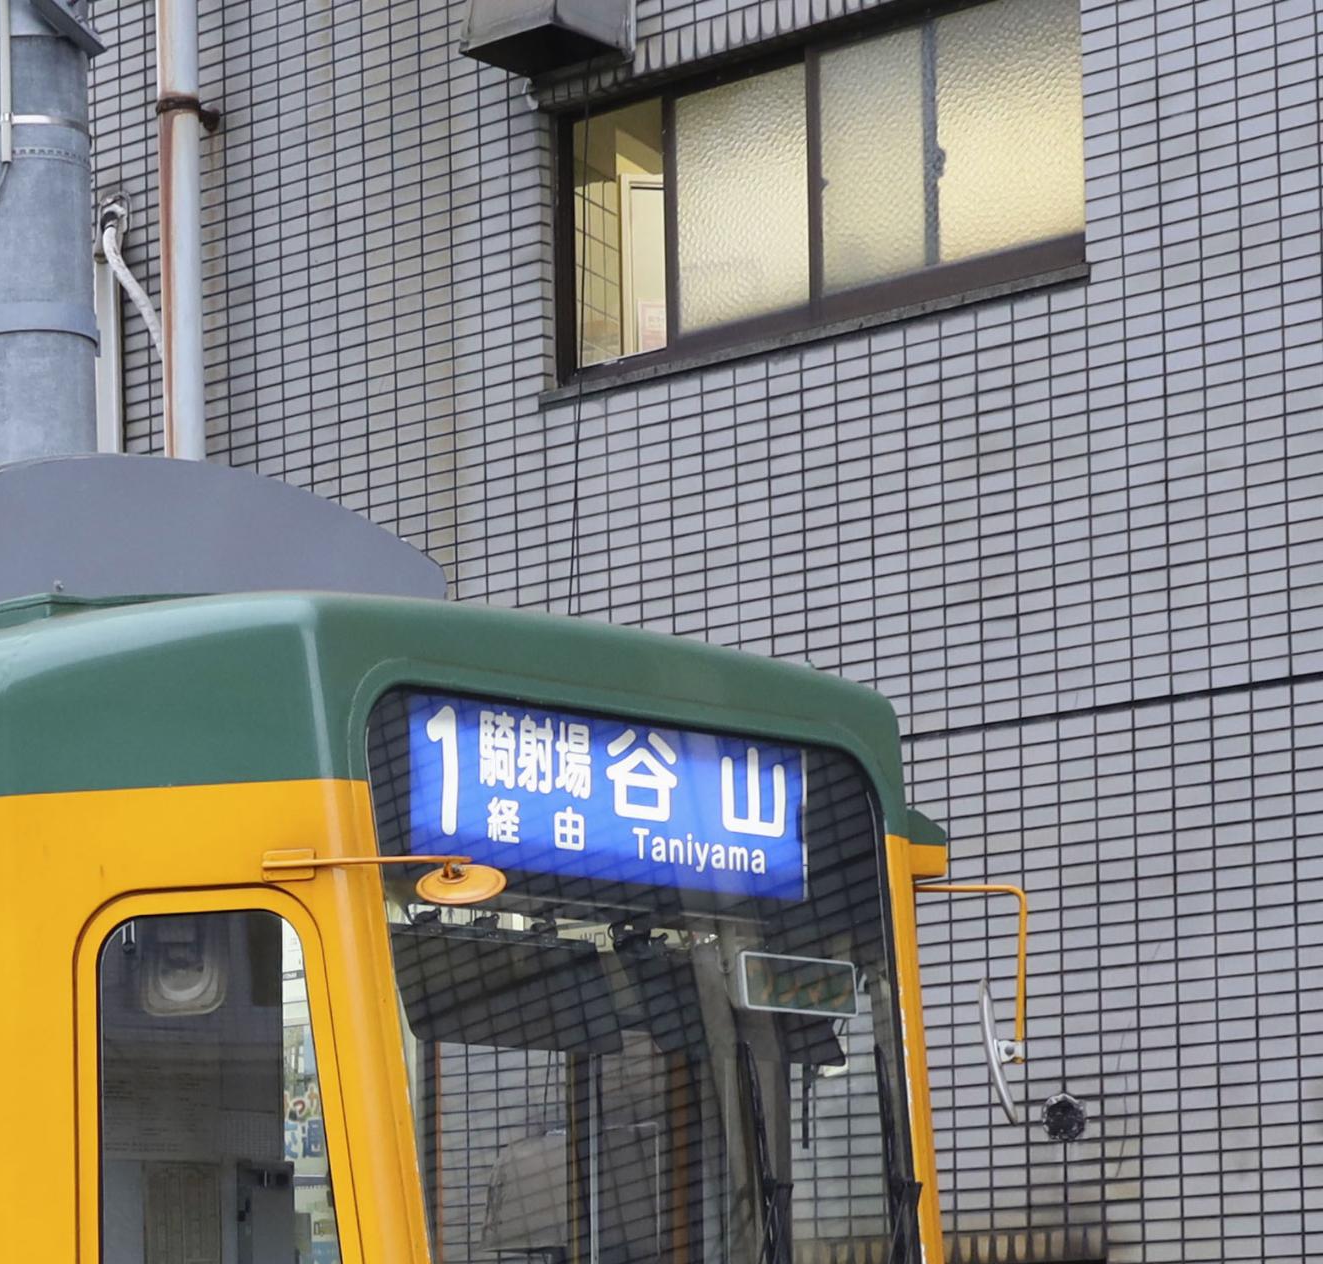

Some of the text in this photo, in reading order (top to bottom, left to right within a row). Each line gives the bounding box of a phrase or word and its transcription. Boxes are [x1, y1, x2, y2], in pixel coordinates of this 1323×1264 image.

[426, 704, 460, 836] 1
[478, 710, 593, 800] 騎射場
[631, 826, 767, 875] Taniyama
